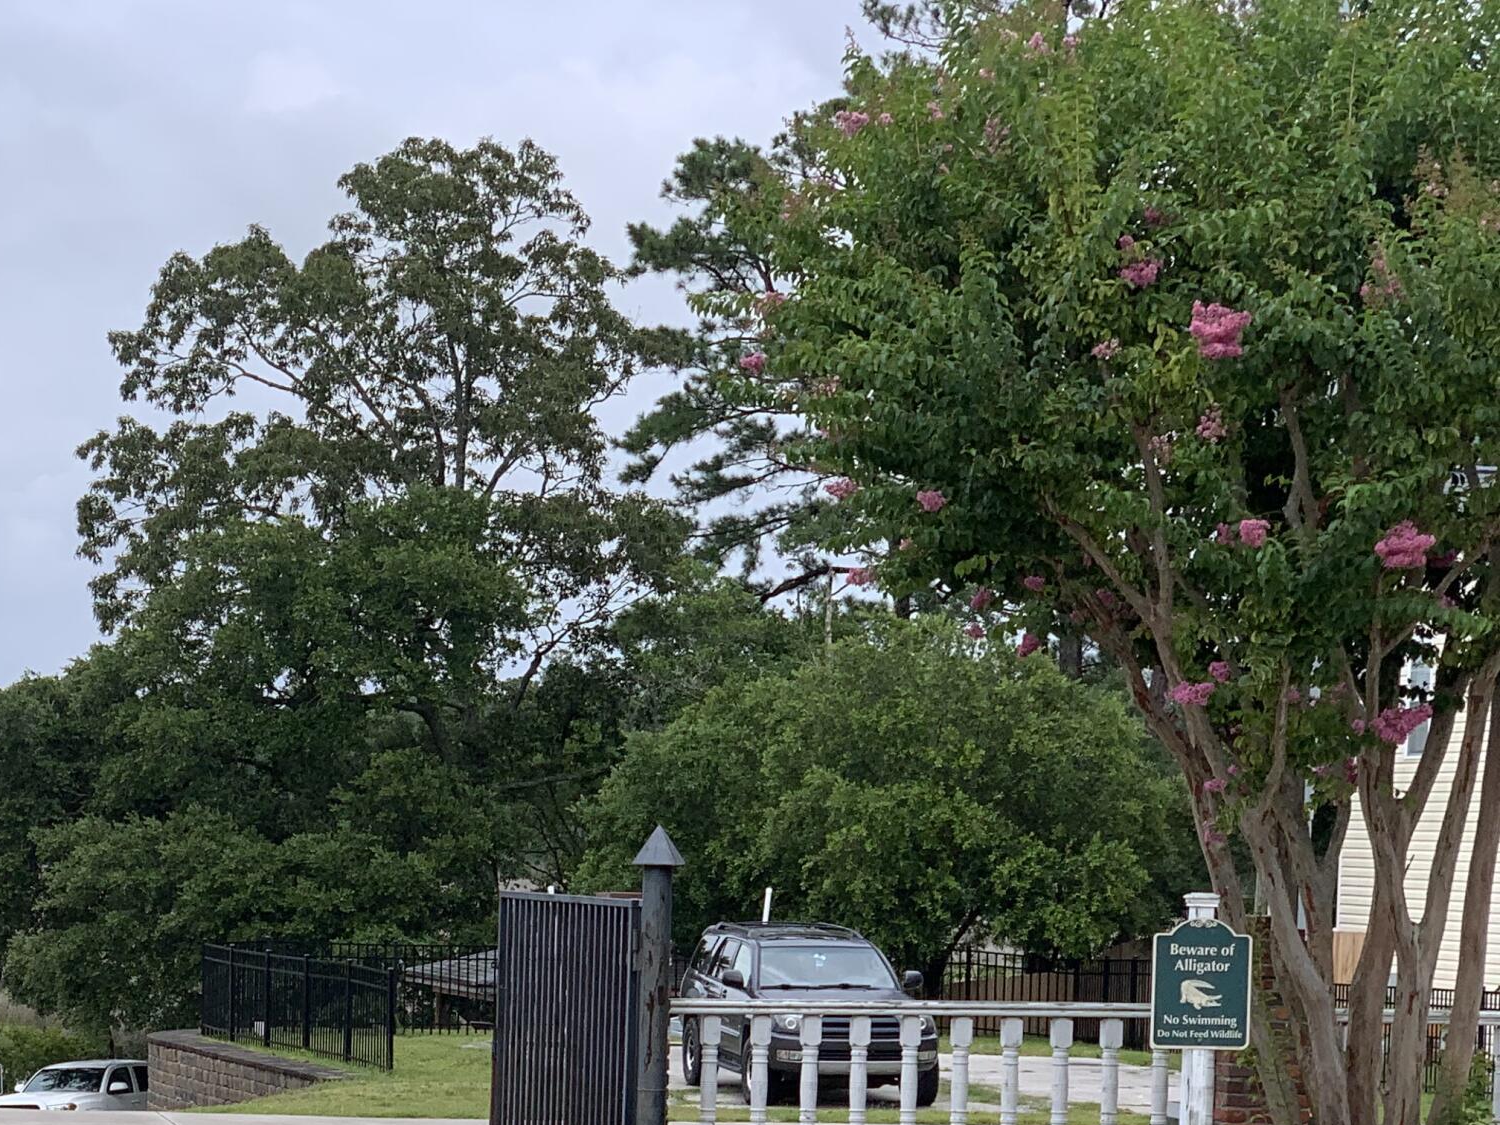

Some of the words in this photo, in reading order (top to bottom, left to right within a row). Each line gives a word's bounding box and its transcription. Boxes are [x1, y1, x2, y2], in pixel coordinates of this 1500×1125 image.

[1170, 943, 1217, 956] Beware
[1221, 944, 1236, 956] of
[1174, 958, 1230, 975] Alligator
[1163, 1015, 1179, 1024] No
[1182, 1015, 1237, 1028] Swimming
[1157, 1029, 1169, 1037] Do
[1210, 1030, 1242, 1038] Wildlife
